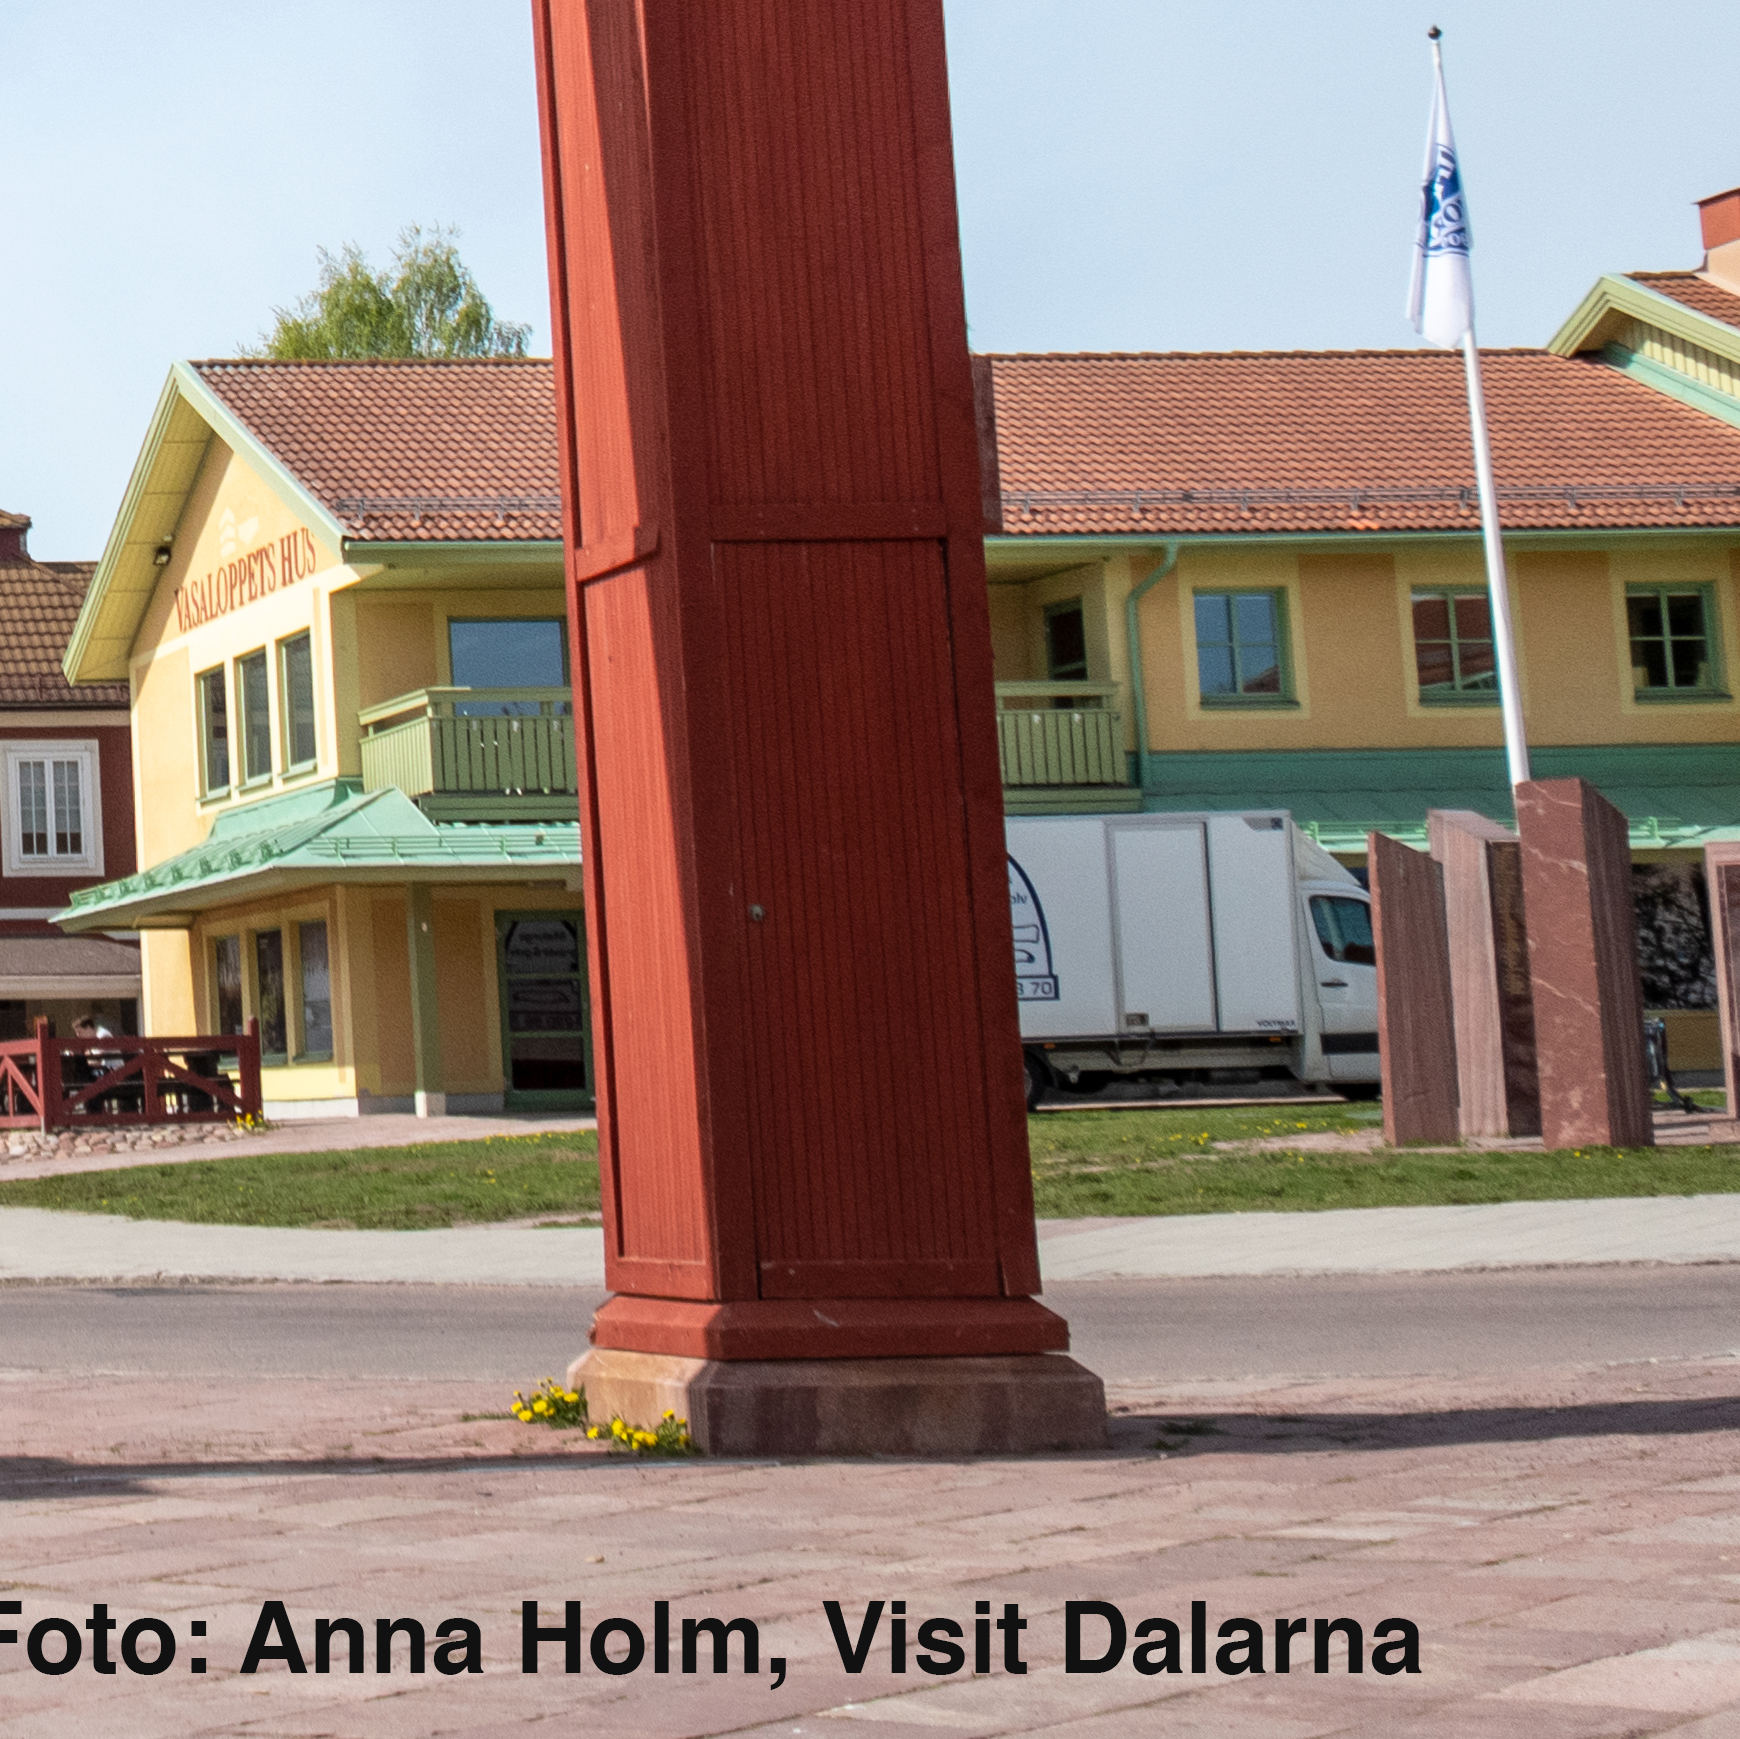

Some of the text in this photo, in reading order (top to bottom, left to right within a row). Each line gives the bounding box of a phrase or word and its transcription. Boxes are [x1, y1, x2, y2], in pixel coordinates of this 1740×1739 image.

[174, 526, 317, 634] VASALOPPETS HUS
[1030, 981, 1053, 996] 70
